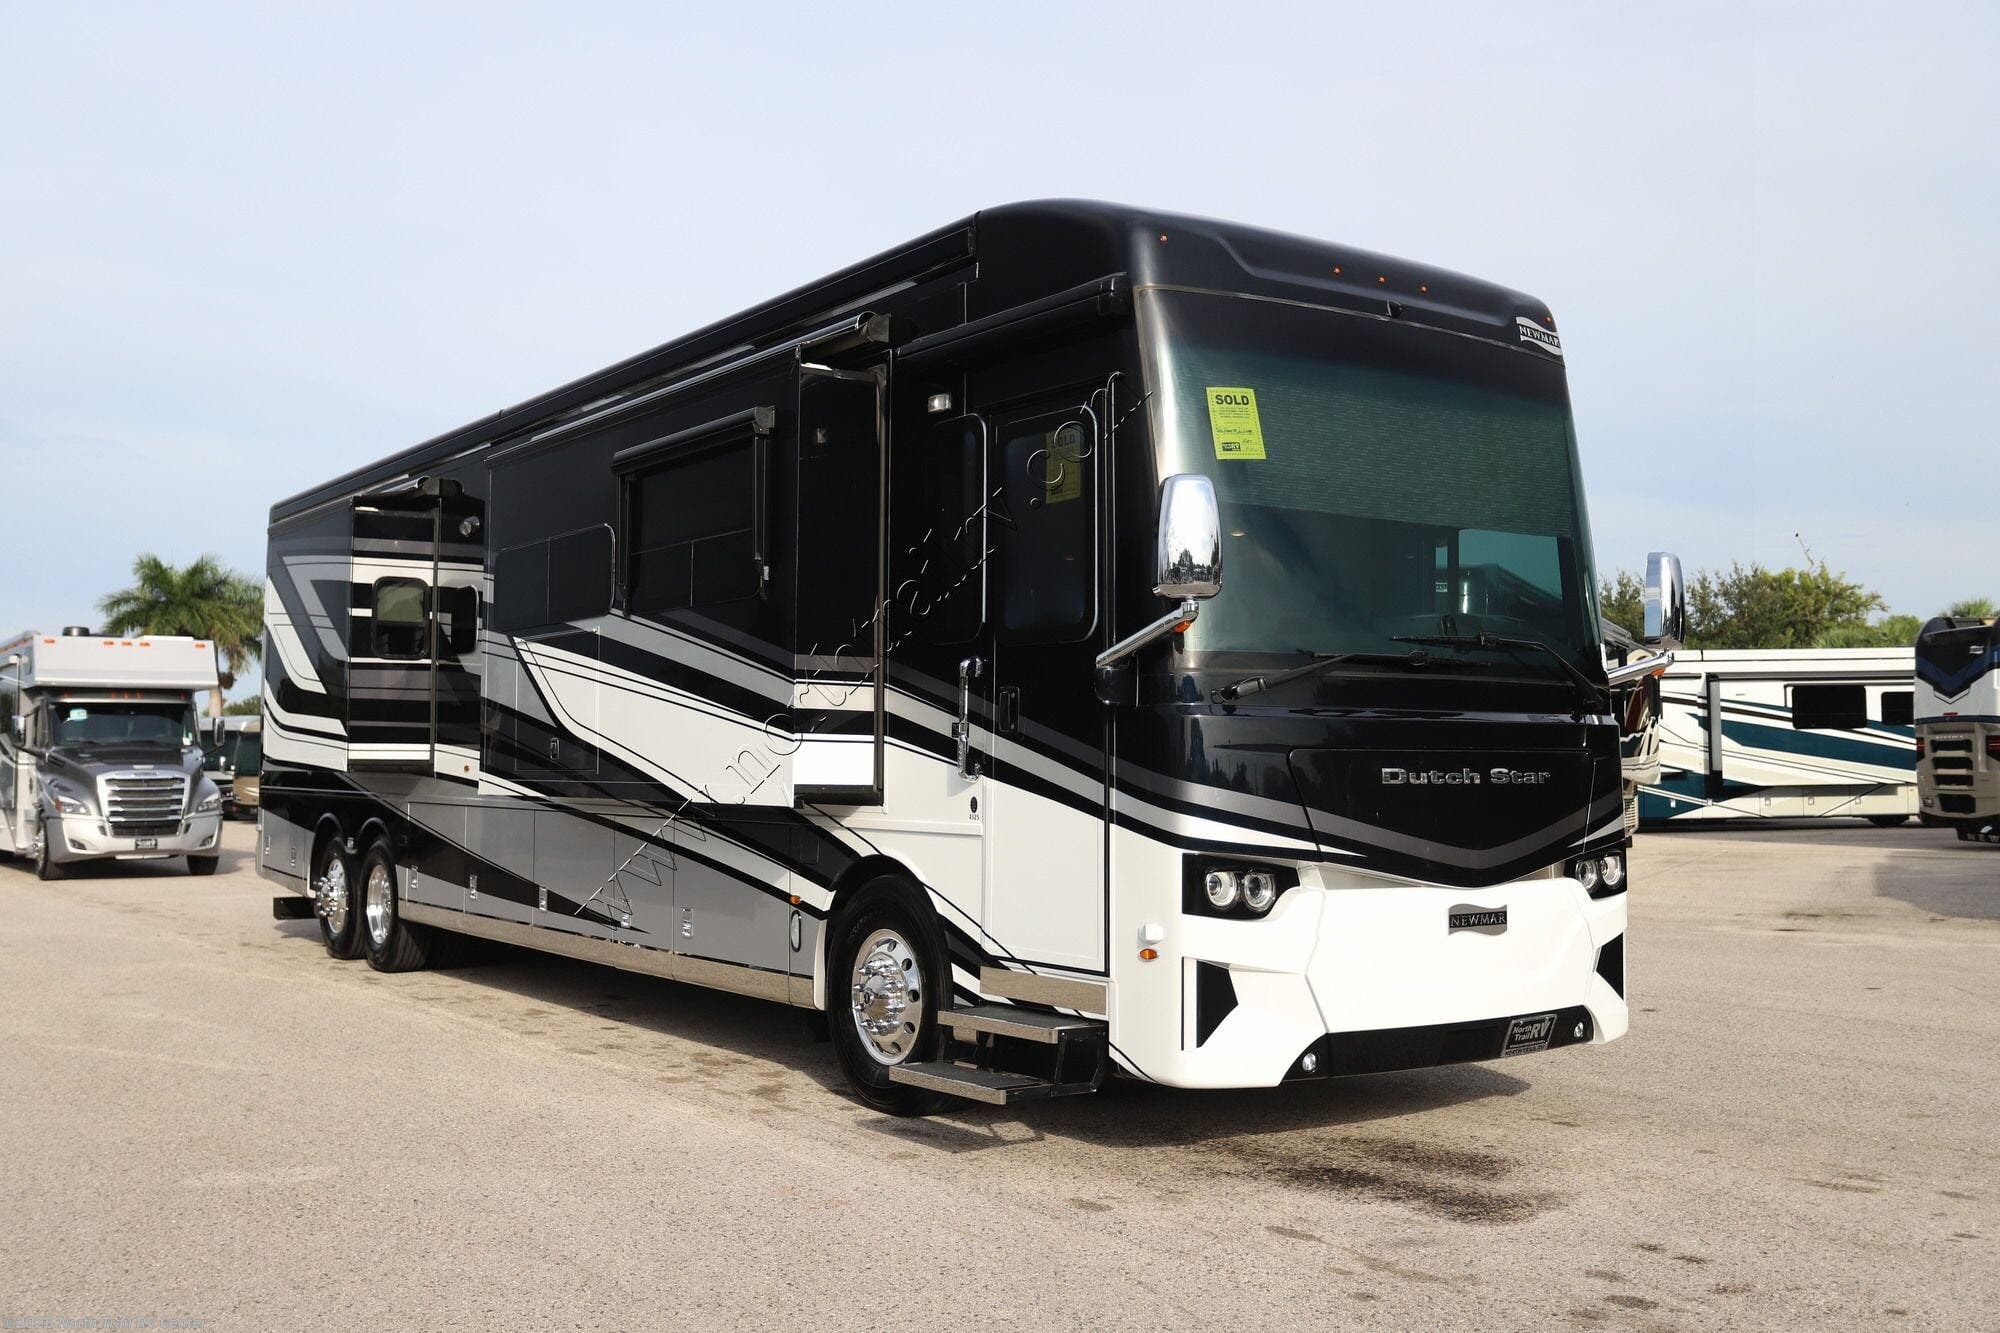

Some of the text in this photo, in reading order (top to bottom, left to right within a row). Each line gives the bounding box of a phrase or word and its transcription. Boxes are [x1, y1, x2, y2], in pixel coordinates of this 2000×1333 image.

[1215, 394, 1249, 405] SOLD
[1381, 767, 1551, 785] Dutch Star
[1450, 912, 1506, 926] NEWMAR
[1530, 1021, 1551, 1039] RV
